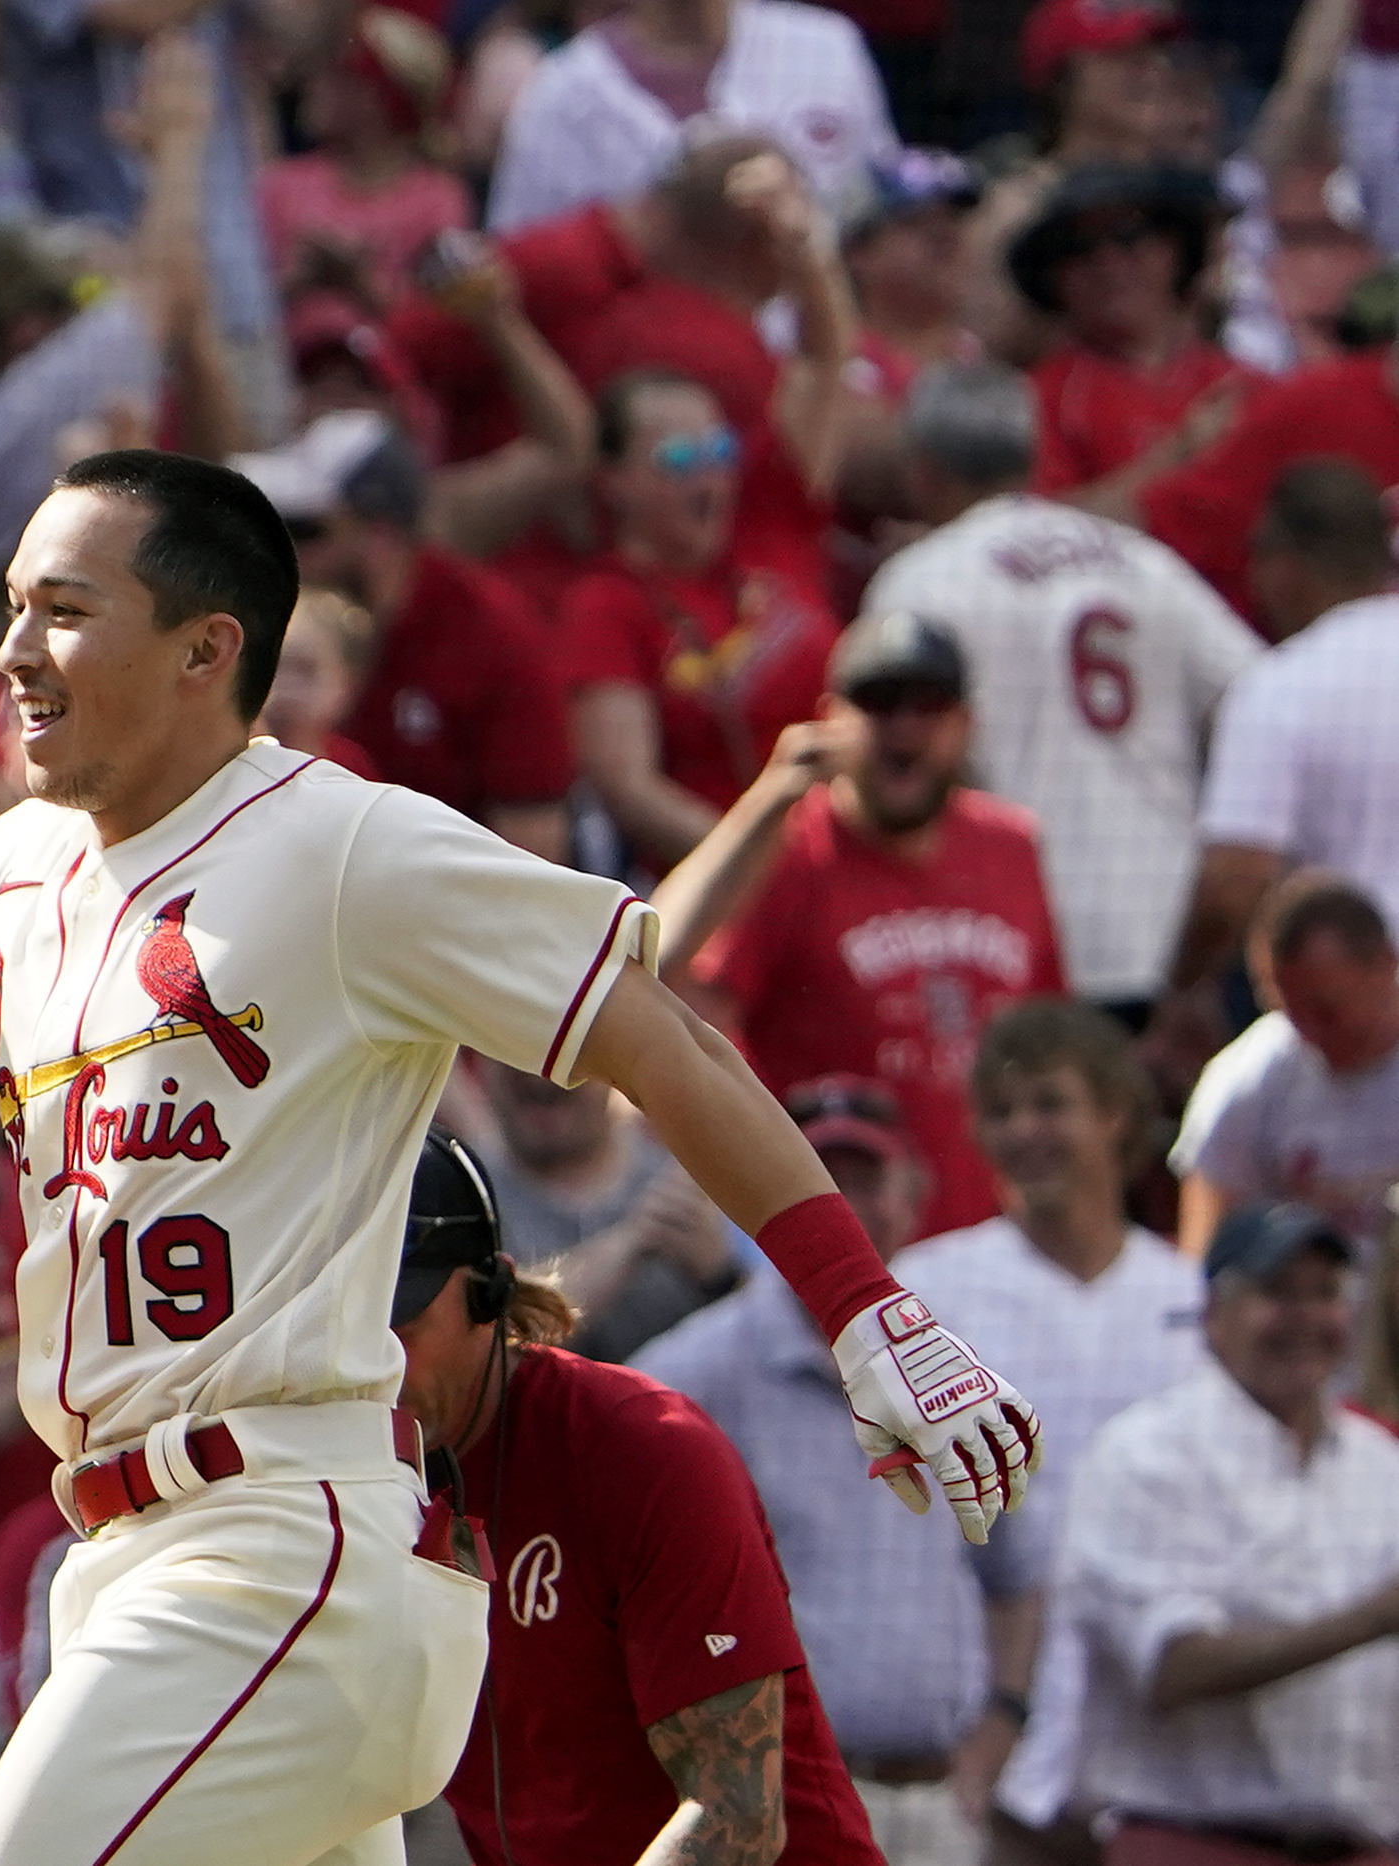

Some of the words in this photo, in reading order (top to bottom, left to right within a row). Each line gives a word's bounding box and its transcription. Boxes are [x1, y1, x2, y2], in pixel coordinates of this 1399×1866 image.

[1068, 605, 1138, 738] 6
[43, 1061, 231, 1203] Louis
[99, 1213, 234, 1346] 19
